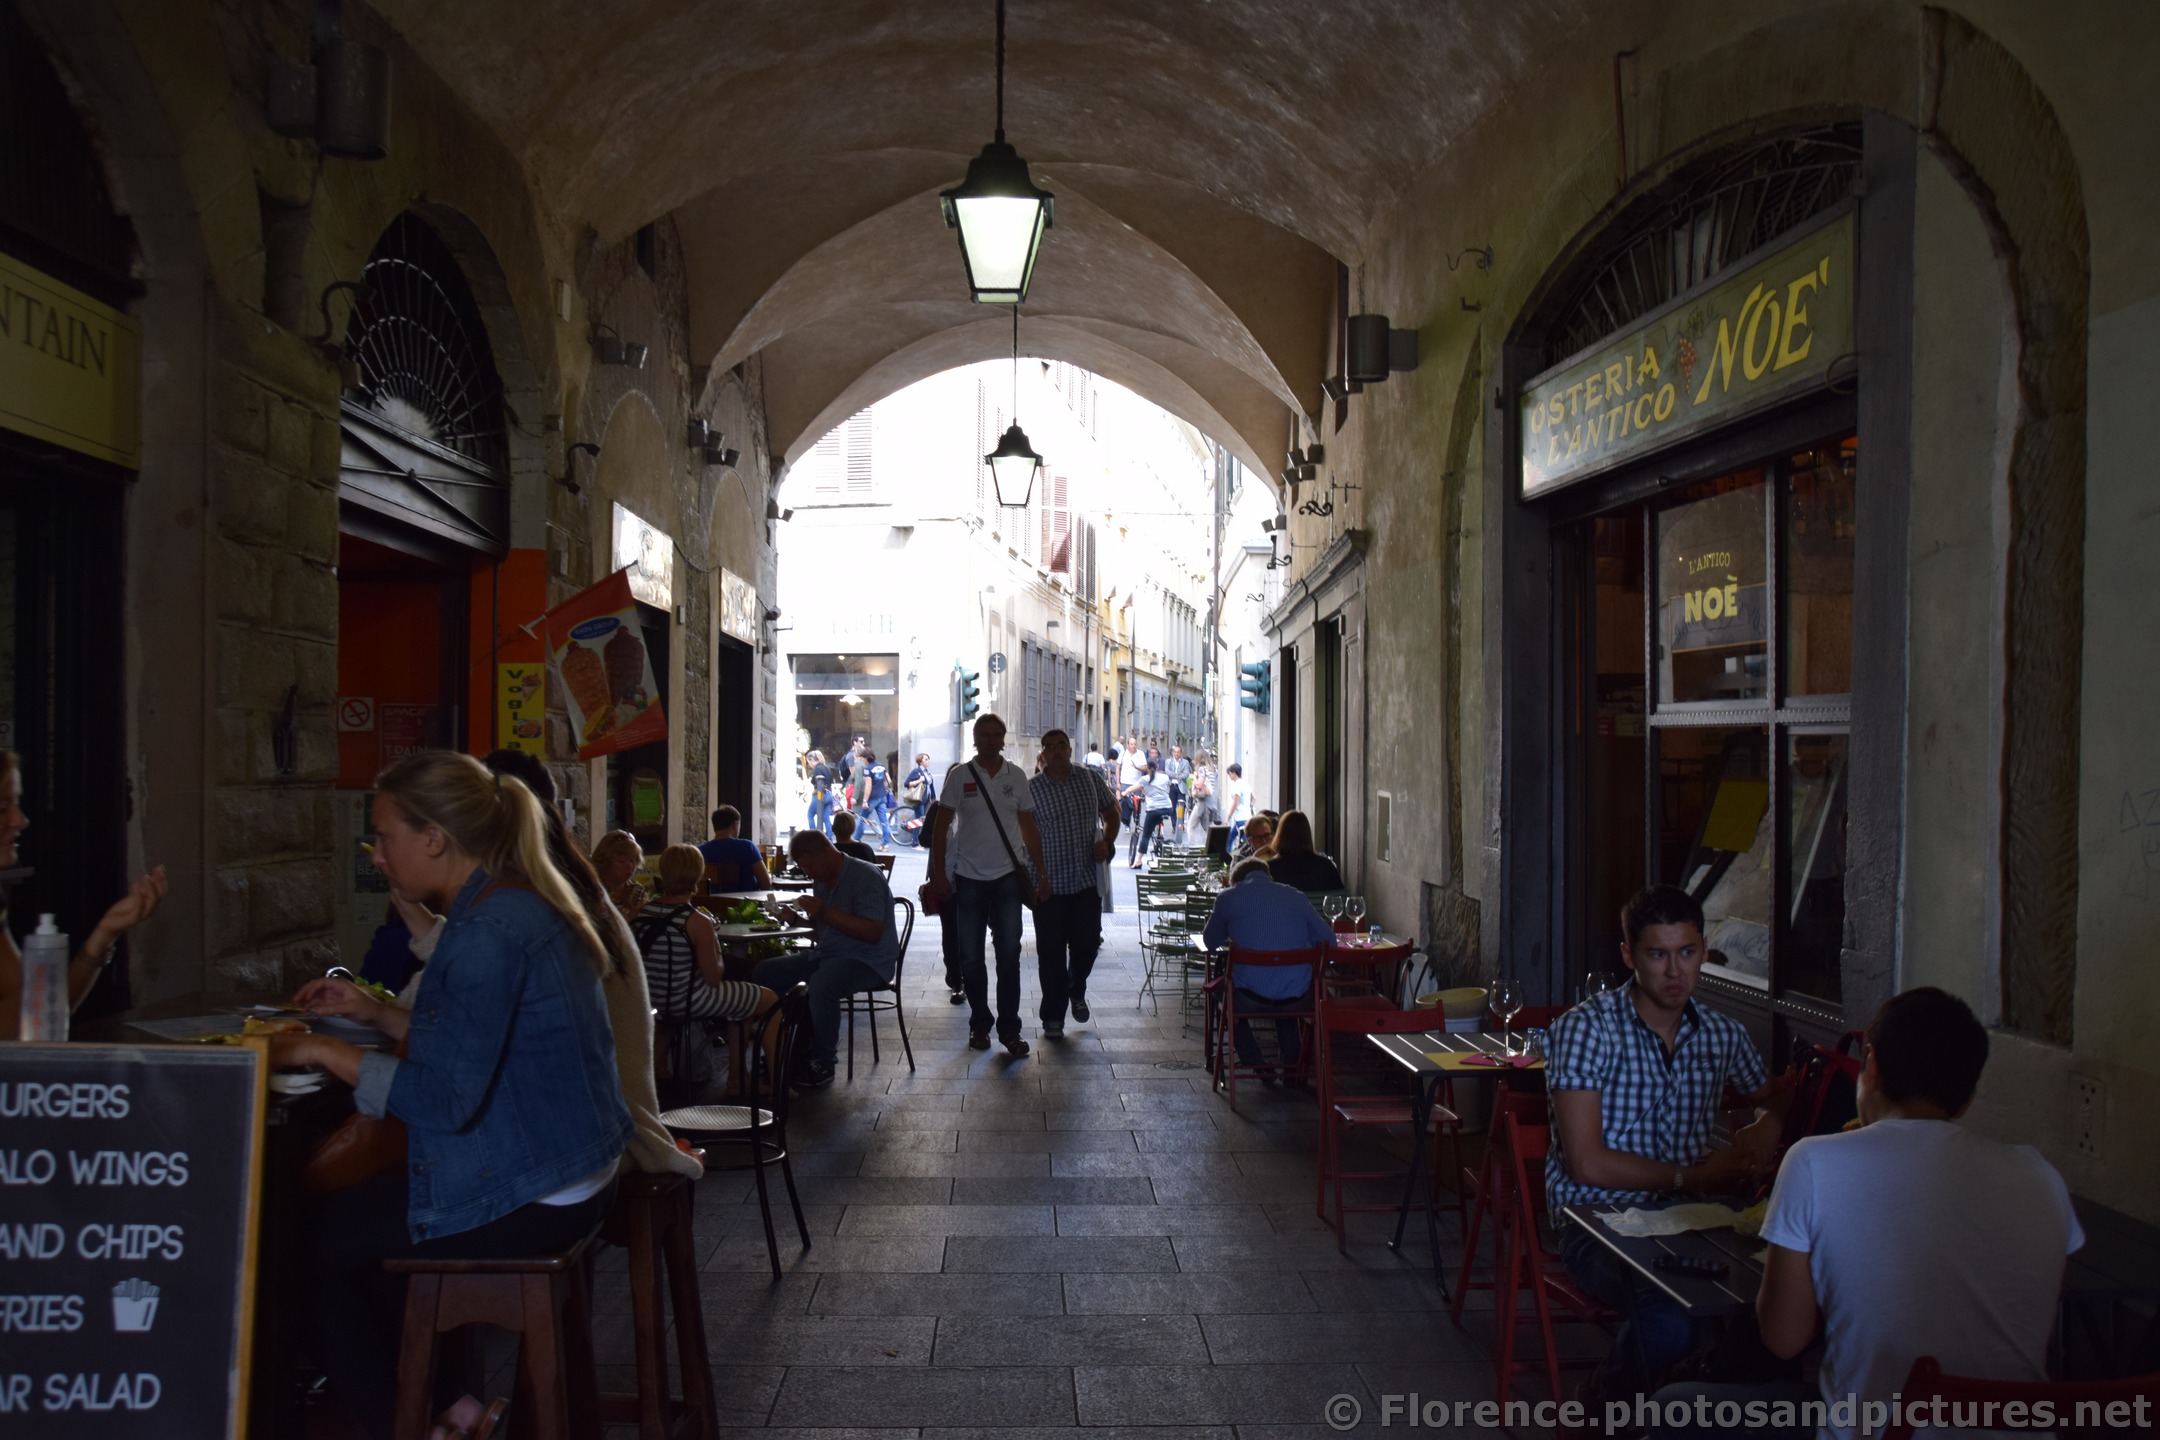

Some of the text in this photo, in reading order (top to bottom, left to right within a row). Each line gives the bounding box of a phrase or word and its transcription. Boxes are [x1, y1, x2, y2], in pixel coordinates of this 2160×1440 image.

[1531, 346, 1661, 435] OSTERIA
[1547, 382, 1676, 467] L'ANTICO
[1688, 551, 1731, 576] L'ANTICO
[1684, 574, 1738, 624] NOÈ
[0, 1082, 131, 1120] URGERS
[68, 1150, 190, 1188] WINGS
[0, 1223, 185, 1261] AND CHIPS
[43, 1372, 162, 1412] SALAD
